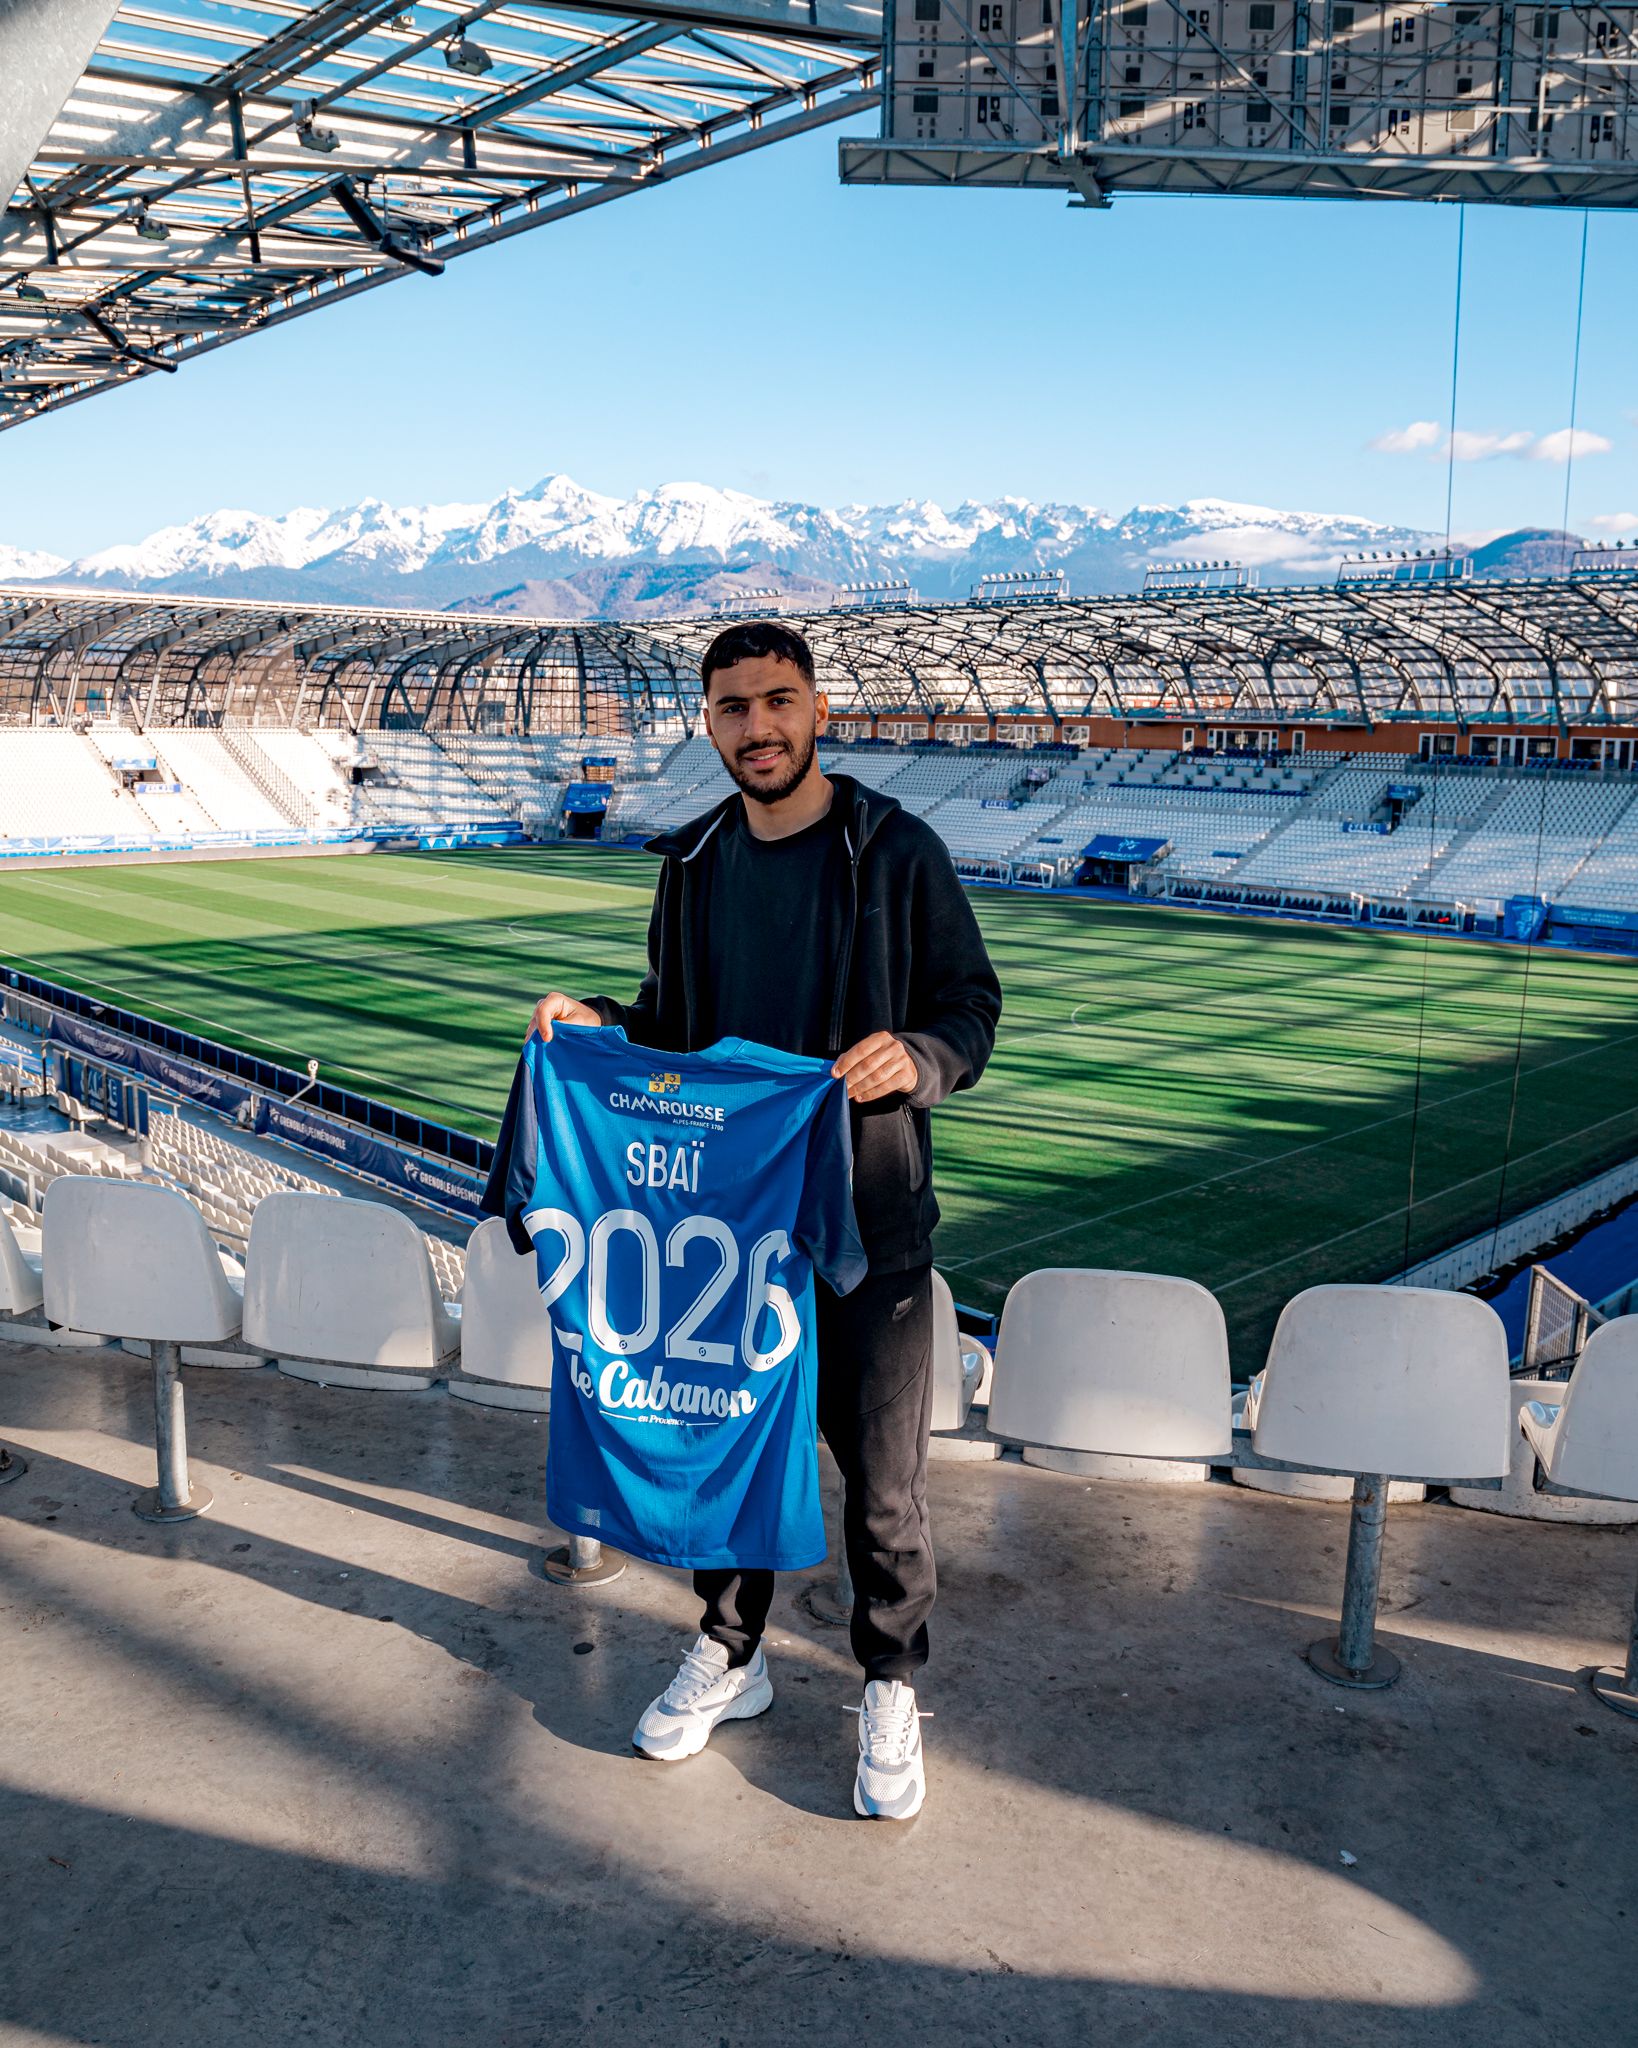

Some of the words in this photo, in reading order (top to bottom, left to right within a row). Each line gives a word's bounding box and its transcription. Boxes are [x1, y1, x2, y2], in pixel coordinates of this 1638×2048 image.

[609, 1092, 725, 1122] CHAMROUSSE
[672, 1118, 710, 1129] ALPES-FRANCE
[710, 1123, 724, 1132] 1700
[626, 1140, 705, 1193] SBAÏ
[522, 1207, 802, 1372] 2026
[570, 1354, 594, 1399] le
[598, 1360, 758, 1418] Cabanon
[638, 1413, 649, 1423] en
[648, 1414, 686, 1427] Provence
